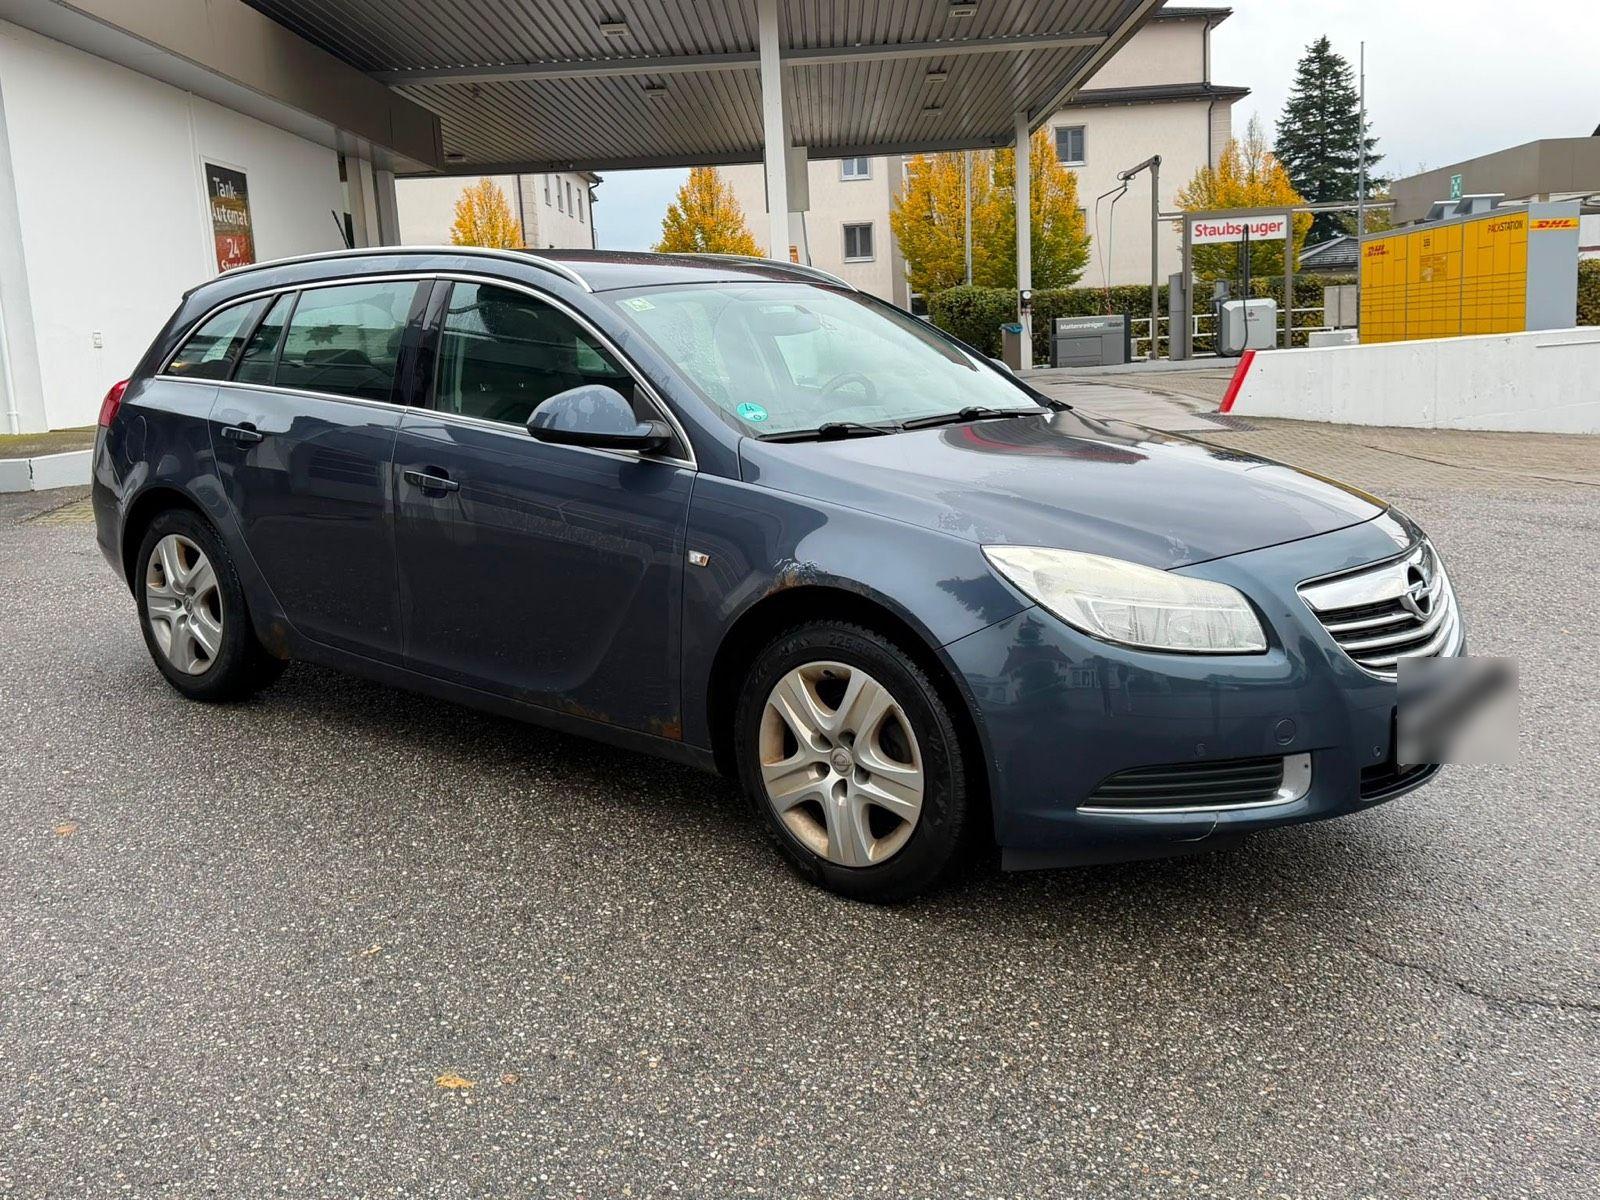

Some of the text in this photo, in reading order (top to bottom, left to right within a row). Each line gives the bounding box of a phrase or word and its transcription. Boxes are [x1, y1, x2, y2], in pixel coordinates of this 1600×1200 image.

[212, 177, 237, 200] Tank-
[211, 202, 249, 226] Automat
[1536, 219, 1572, 229] DHL
[1194, 222, 1284, 237] Staubsauger
[226, 238, 241, 259] 24
